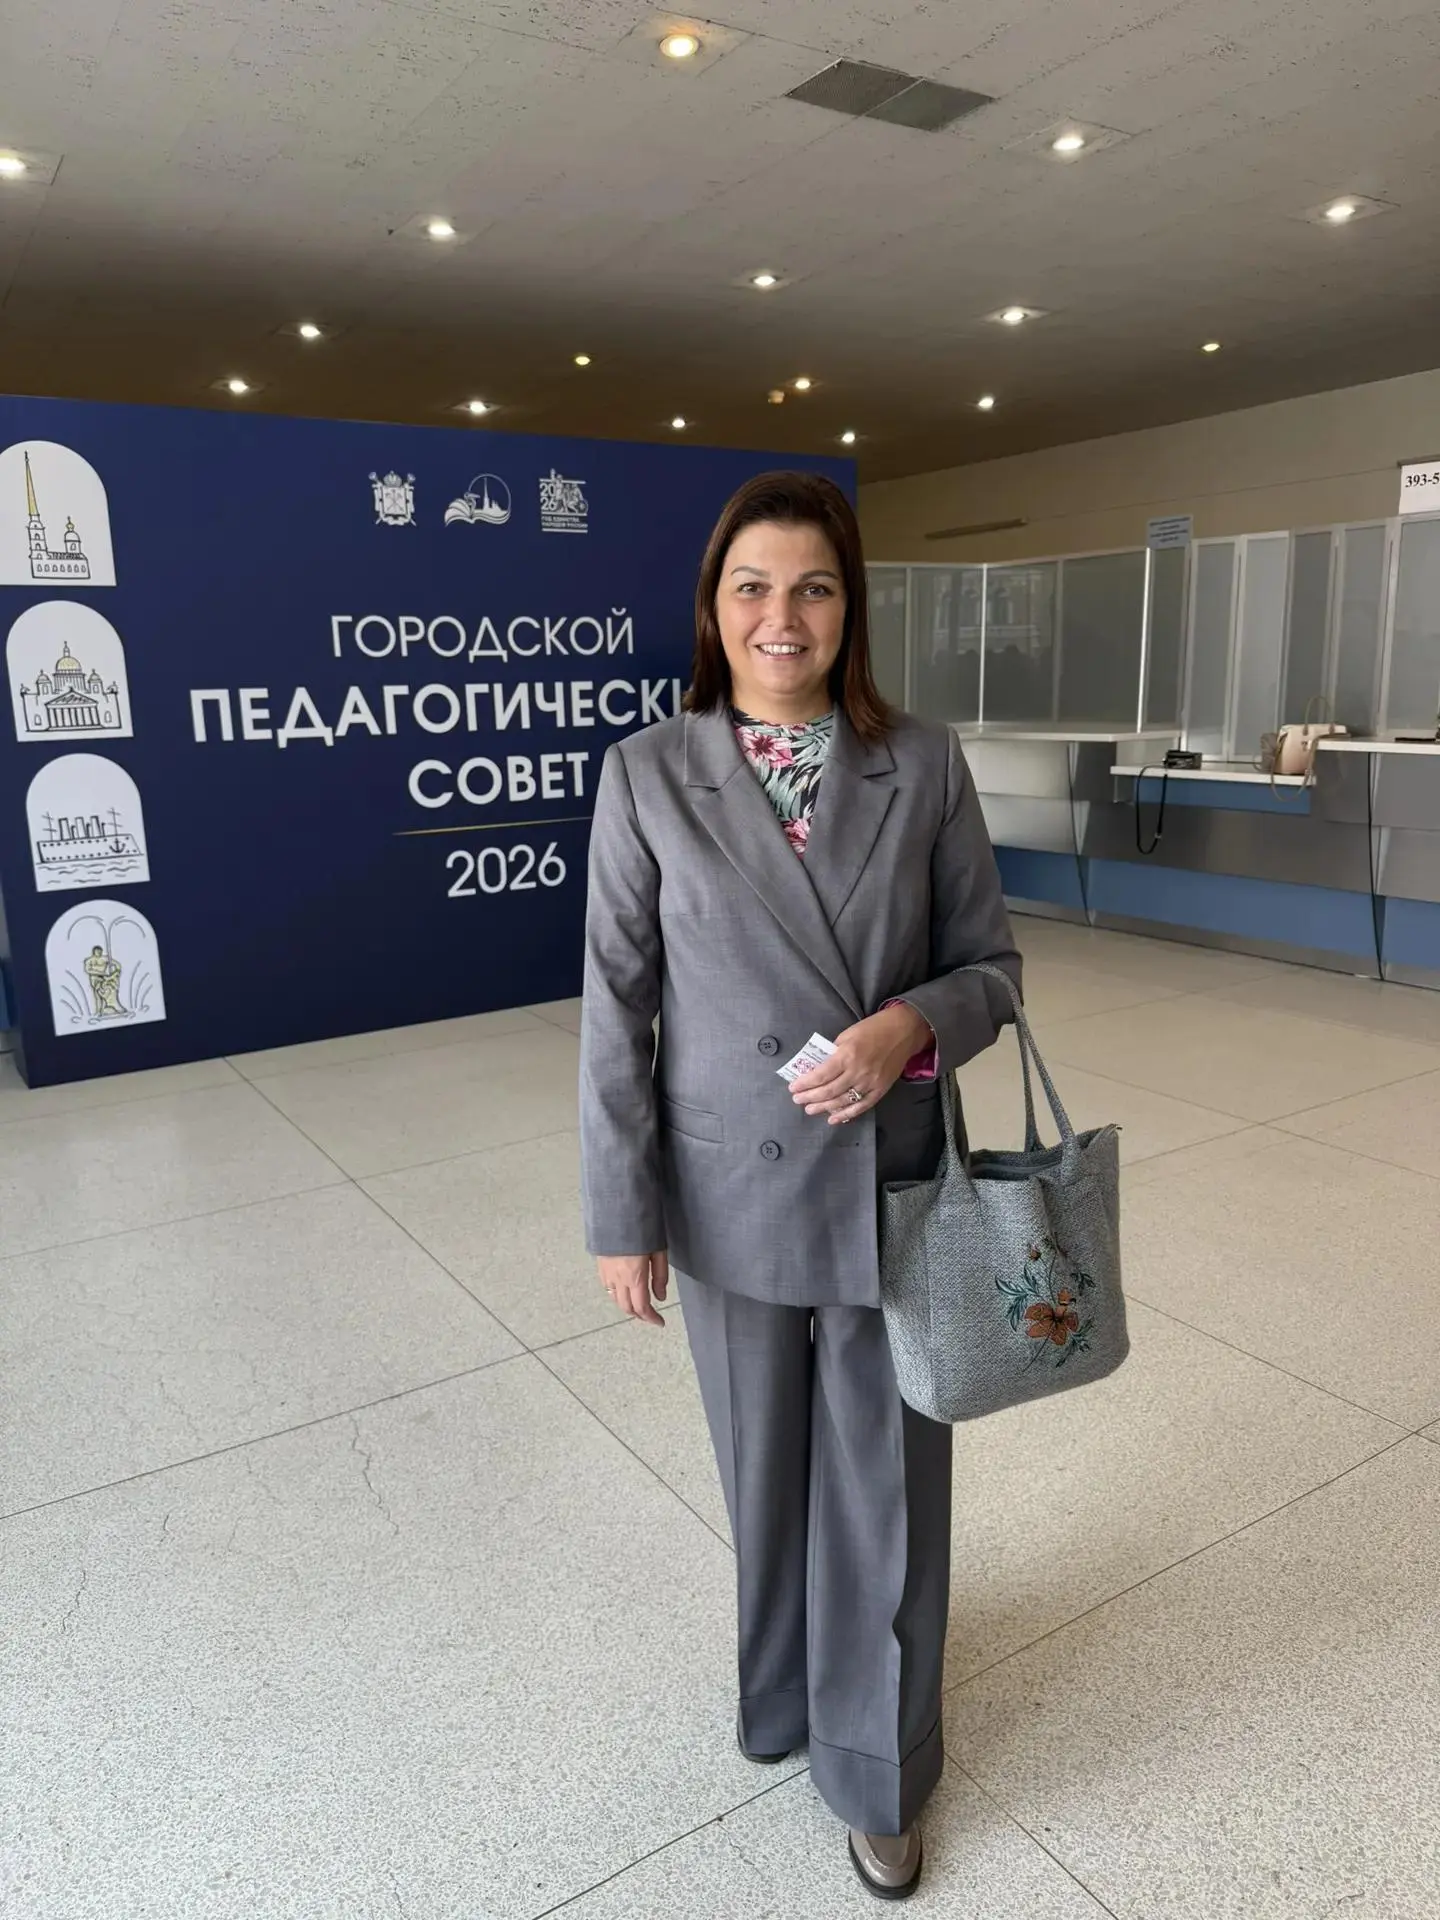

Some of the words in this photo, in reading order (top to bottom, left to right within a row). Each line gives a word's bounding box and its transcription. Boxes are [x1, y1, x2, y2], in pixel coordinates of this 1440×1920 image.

[539, 483, 555, 497] 20
[540, 497, 557, 511] 26
[331, 607, 634, 664] ГОРОДСКОЙ
[408, 752, 589, 809] СОВЕТ
[446, 842, 567, 898] 2026
